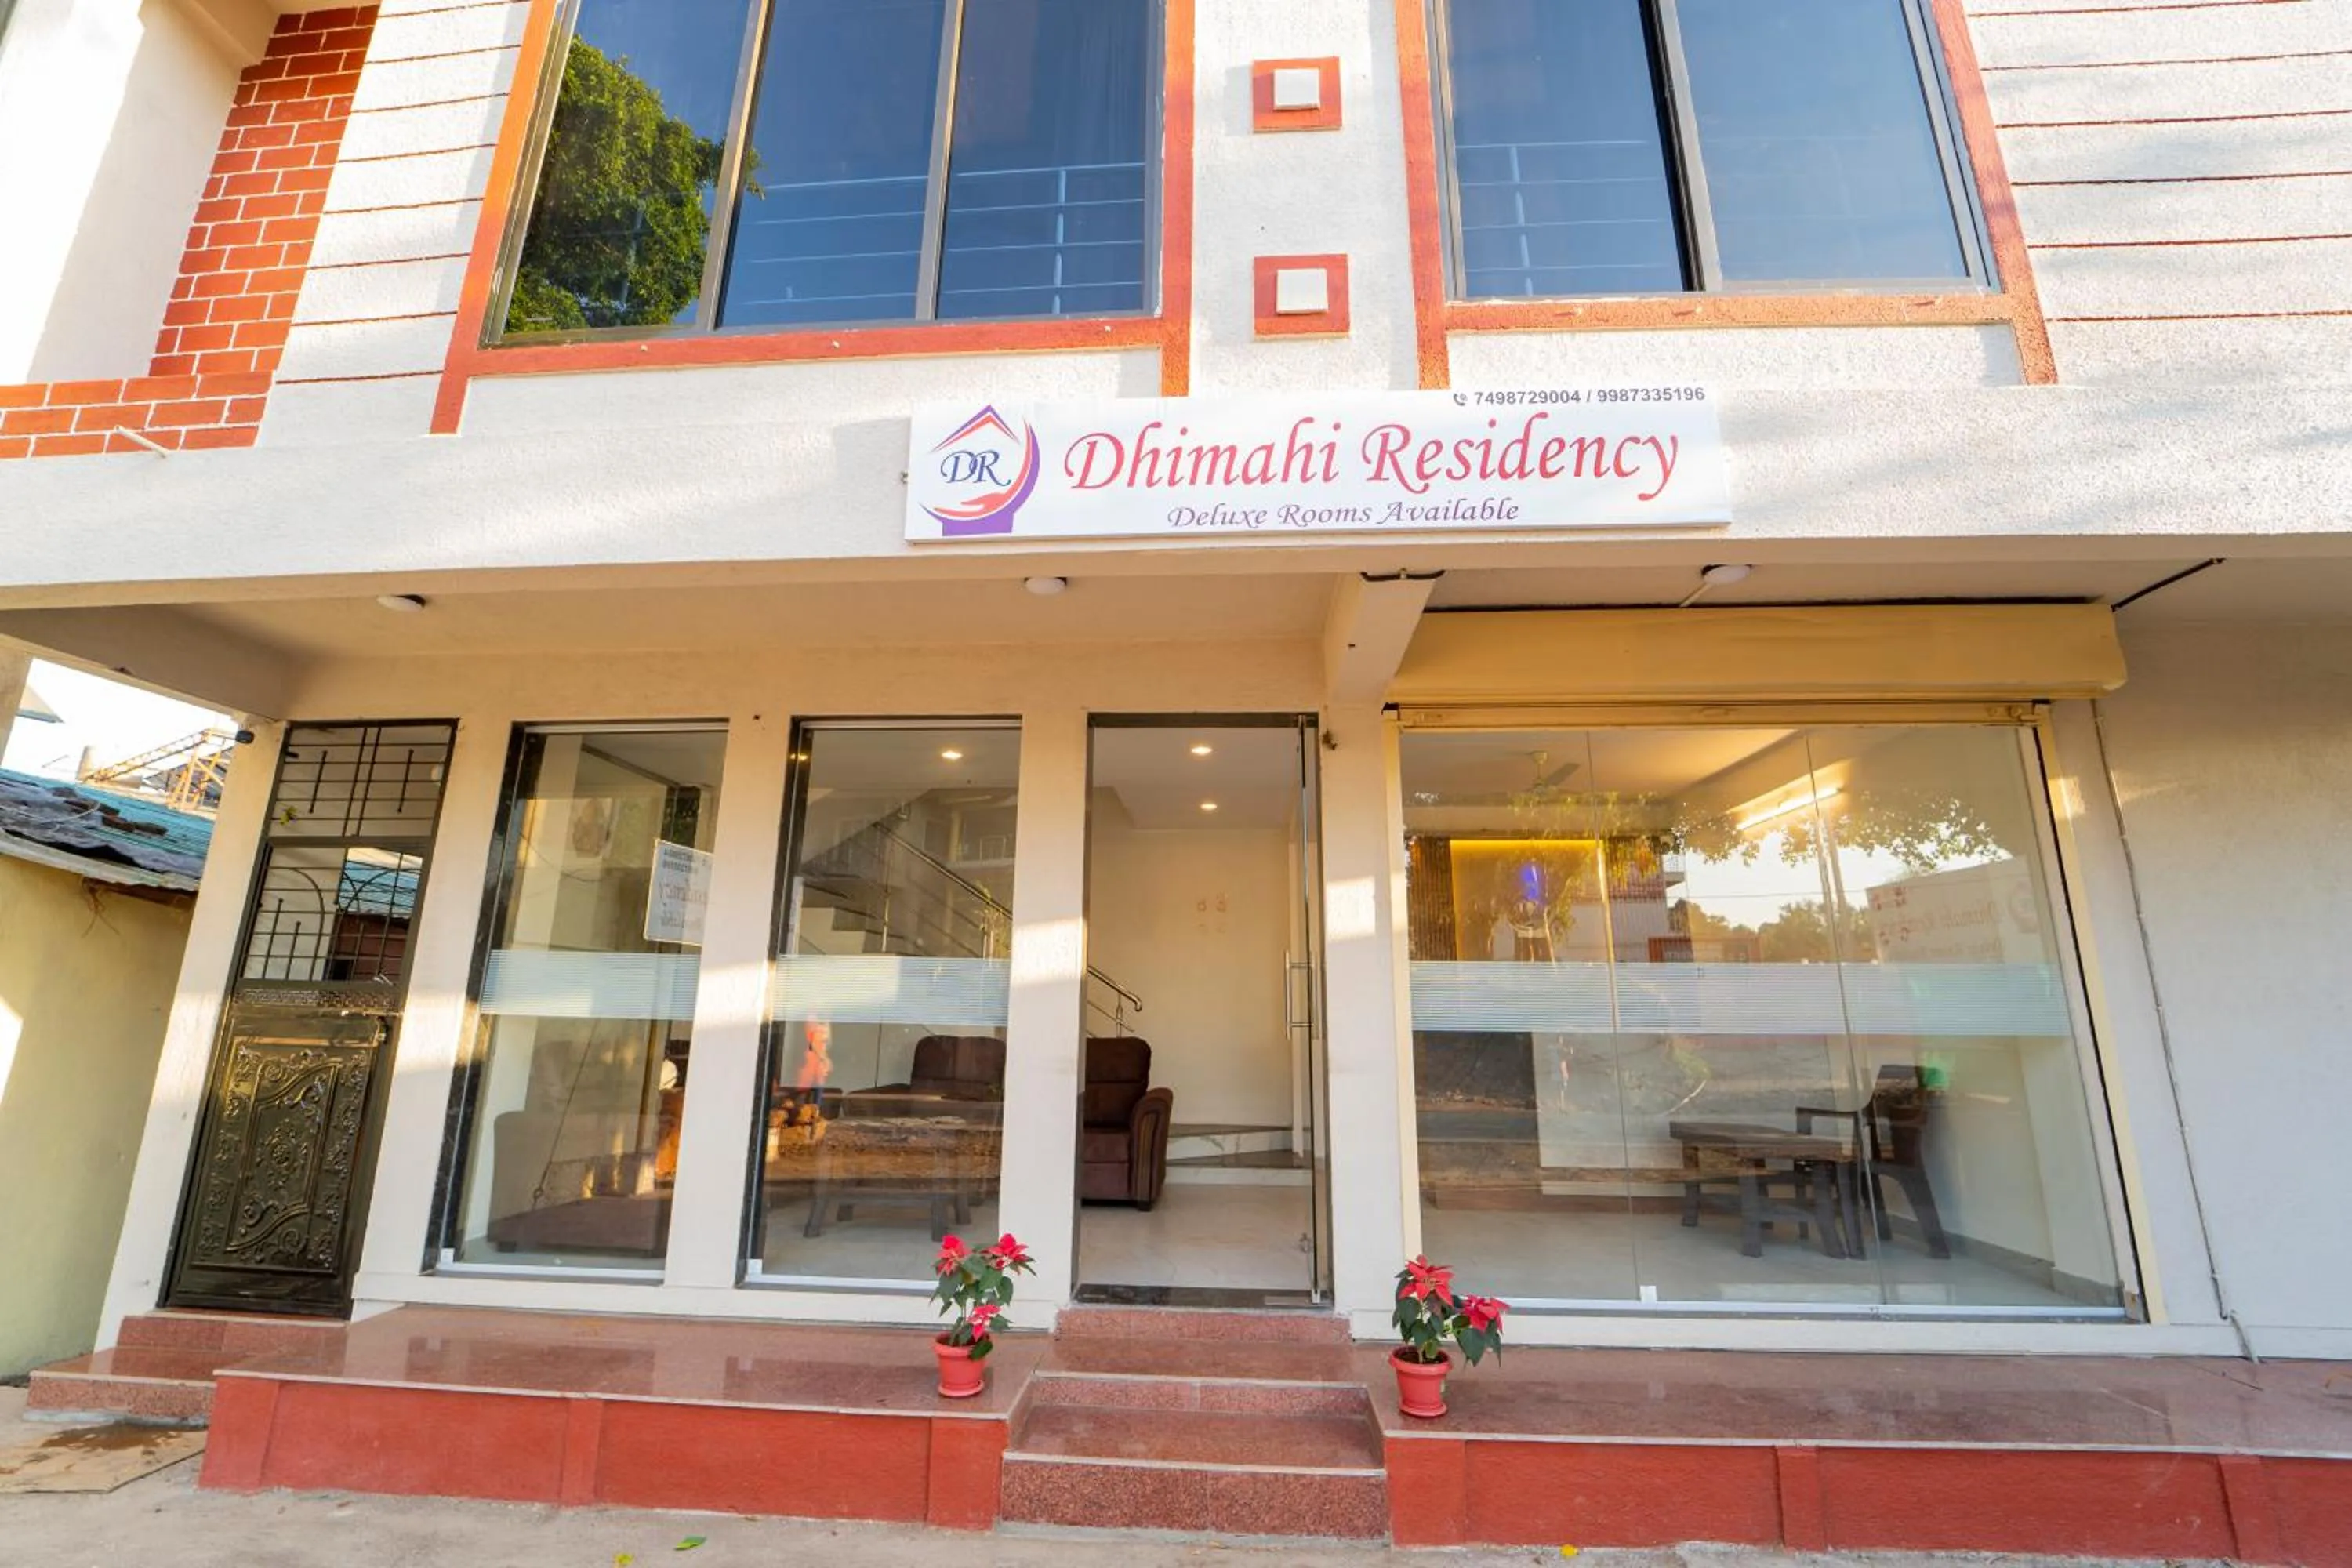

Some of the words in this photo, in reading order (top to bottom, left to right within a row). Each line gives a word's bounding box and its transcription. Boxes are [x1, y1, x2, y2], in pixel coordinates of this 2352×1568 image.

[1475, 390, 1581, 405] 7498729004
[1586, 389, 1592, 403] /
[1597, 387, 1706, 402] 9987335196
[940, 449, 1013, 487] DR
[1064, 416, 1342, 490] Dhimahi
[1361, 411, 1679, 502] Residency
[1167, 503, 1268, 529] Deluxe
[1277, 503, 1373, 528] Rooms
[1376, 497, 1519, 524] Available
